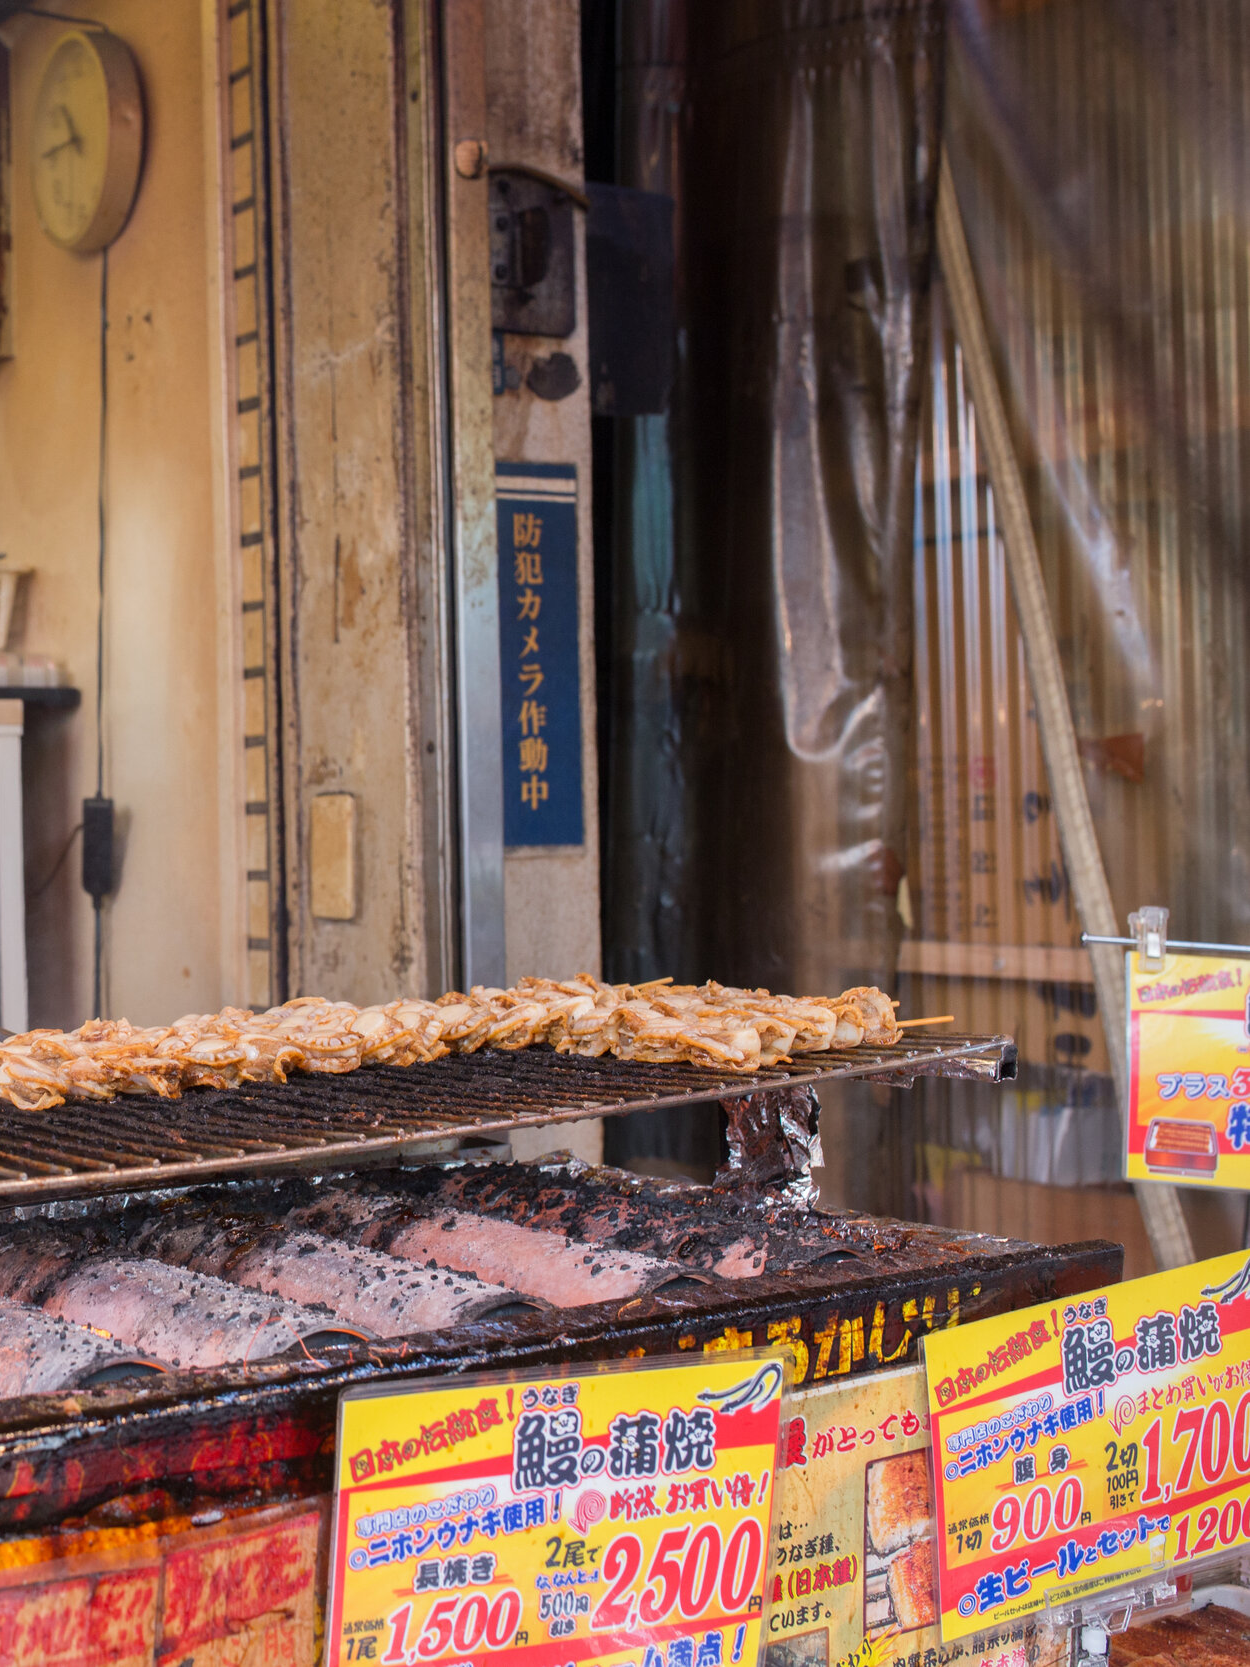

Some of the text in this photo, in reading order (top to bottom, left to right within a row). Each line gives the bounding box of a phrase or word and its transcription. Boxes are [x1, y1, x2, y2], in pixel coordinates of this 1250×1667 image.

[512, 513, 550, 811] 防犯カメラ作動中
[1064, 1297, 1108, 1324] うなぎ
[935, 1308, 1060, 1407] 日本の伝統食！
[1062, 1302, 1222, 1394] 鰻の蒲焼
[521, 1384, 580, 1408] うなぎ
[946, 1393, 1053, 1451] 専門店のこだわり
[514, 1407, 716, 1491] 鰻の蒲焼
[1105, 1440, 1139, 1473] 2切
[1106, 1469, 1139, 1493] 100円
[355, 1484, 497, 1536] 専門店のこだわり
[1110, 1489, 1137, 1510] 引きで
[947, 1512, 990, 1535] 通常価格
[544, 1536, 602, 1569] 2尾で
[956, 1529, 983, 1554] 1切
[415, 1552, 497, 1592] 長焼き
[539, 1590, 590, 1620] 500円
